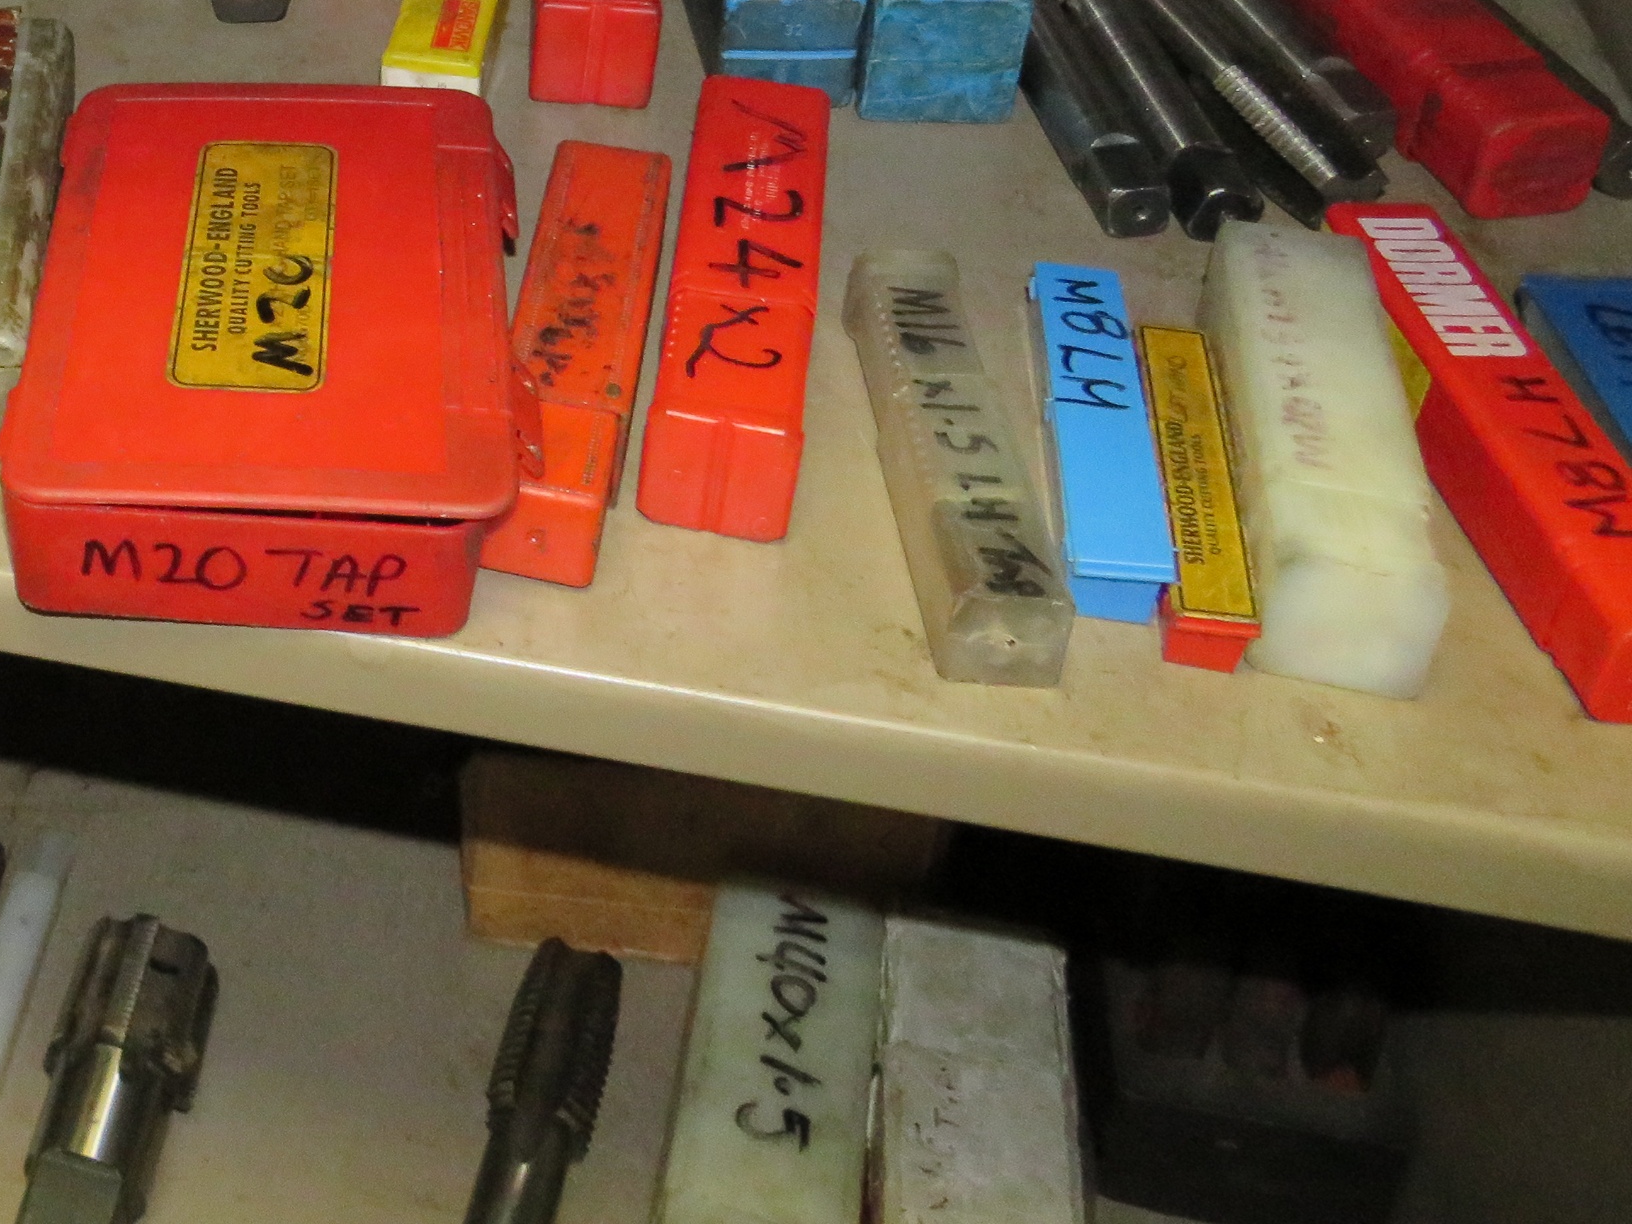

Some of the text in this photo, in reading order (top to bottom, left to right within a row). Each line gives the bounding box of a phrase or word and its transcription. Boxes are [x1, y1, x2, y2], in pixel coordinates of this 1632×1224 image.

[191, 167, 239, 352] SHERWOOD-ENGLAND
[228, 181, 262, 336] QUALITY CUTTING TOOLS
[1357, 217, 1528, 358] DORMER
[1165, 421, 1206, 566] SHERWOOD-ENGLAND
[1190, 433, 1204, 464] TOOLS
[81, 537, 409, 598] M20 TAP
[1204, 512, 1222, 555] QUALITY
[300, 599, 421, 628] SET
